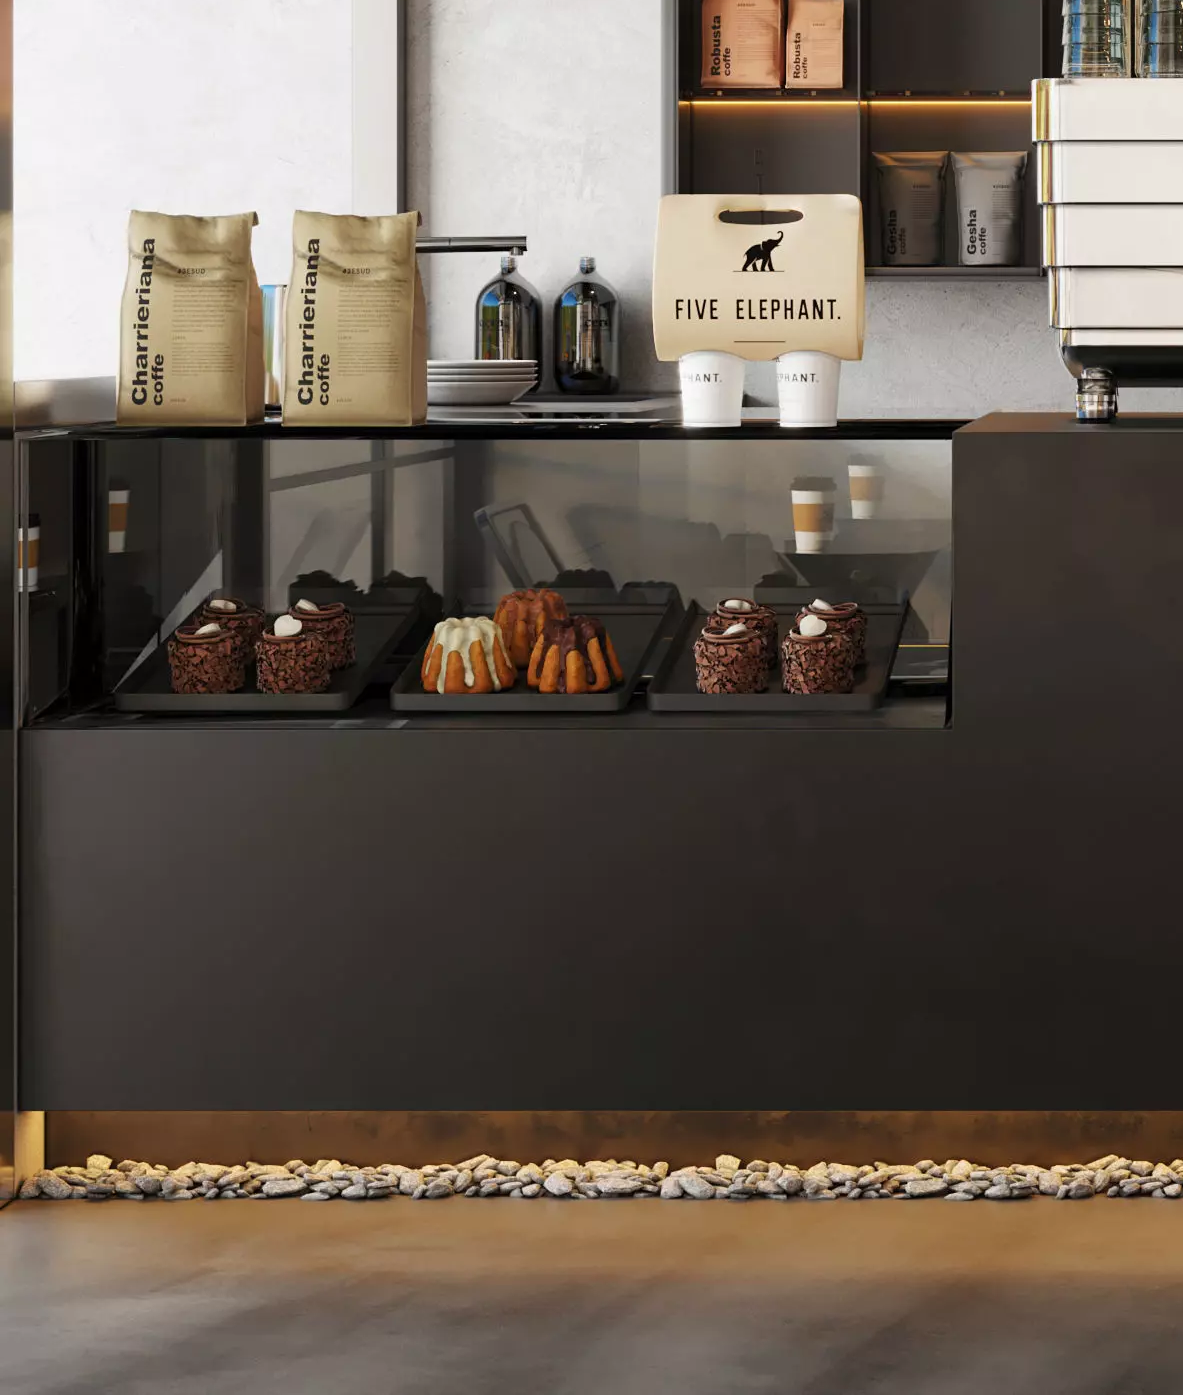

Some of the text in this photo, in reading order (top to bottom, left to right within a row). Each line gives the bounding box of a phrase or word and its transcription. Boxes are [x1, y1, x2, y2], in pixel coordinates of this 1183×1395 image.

[710, 15, 721, 77] Robusta
[722, 47, 731, 77] coffe
[793, 32, 801, 79] Robusta
[887, 209, 898, 255] Gesha
[966, 209, 977, 255] Gesha
[131, 238, 156, 406] Charrieriana
[297, 238, 321, 406] Charrieriana
[675, 299, 841, 320] FIVE ELEPHANT.
[151, 353, 164, 406] coffe
[317, 353, 331, 406] coffe
